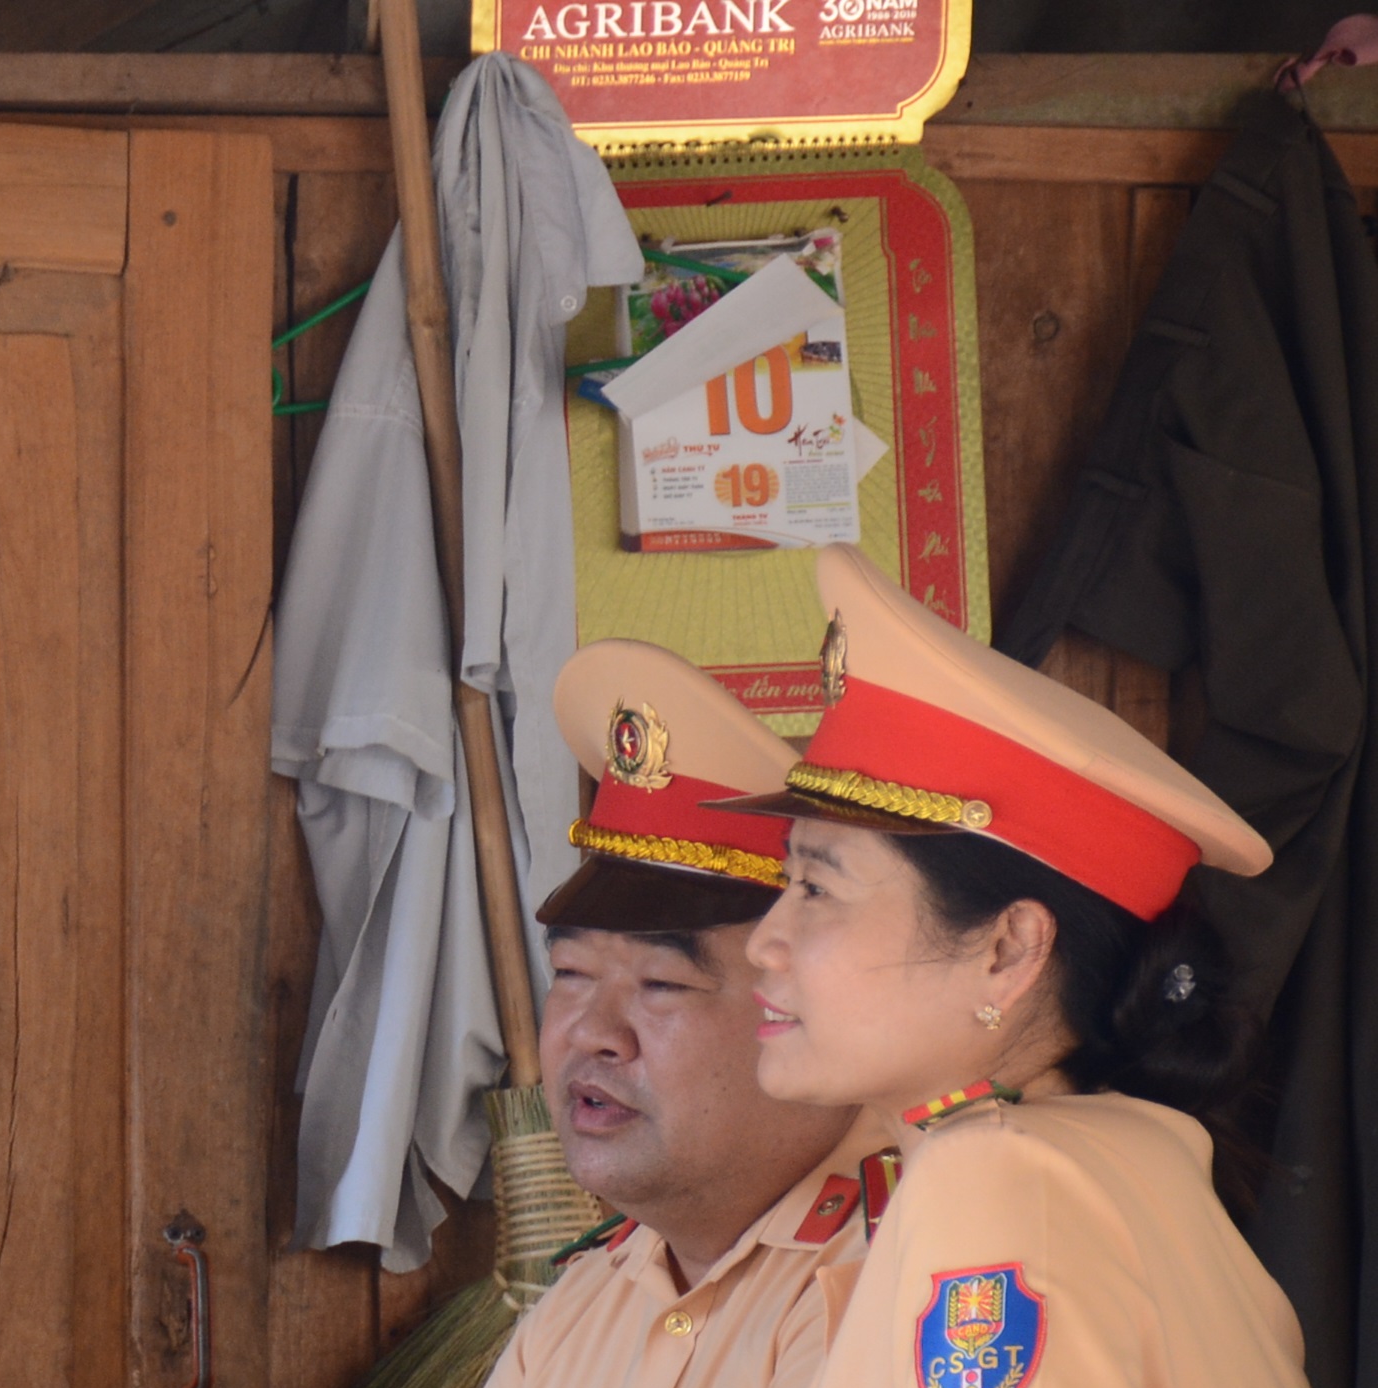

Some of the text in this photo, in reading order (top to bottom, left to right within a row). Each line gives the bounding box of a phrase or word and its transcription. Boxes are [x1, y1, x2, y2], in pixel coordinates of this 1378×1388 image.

[522, 0, 795, 40] AGRIBANK
[819, 22, 915, 39] AGRIBANK
[520, 45, 551, 60] CHI
[555, 40, 614, 59] NHÁNH
[618, 41, 654, 57] LAO
[656, 38, 692, 56] BẢO
[703, 35, 763, 58] QUẢNG
[768, 37, 795, 55] TRỊ
[704, 344, 793, 436] 10
[722, 463, 770, 508] 19
[743, 675, 782, 698] đến
